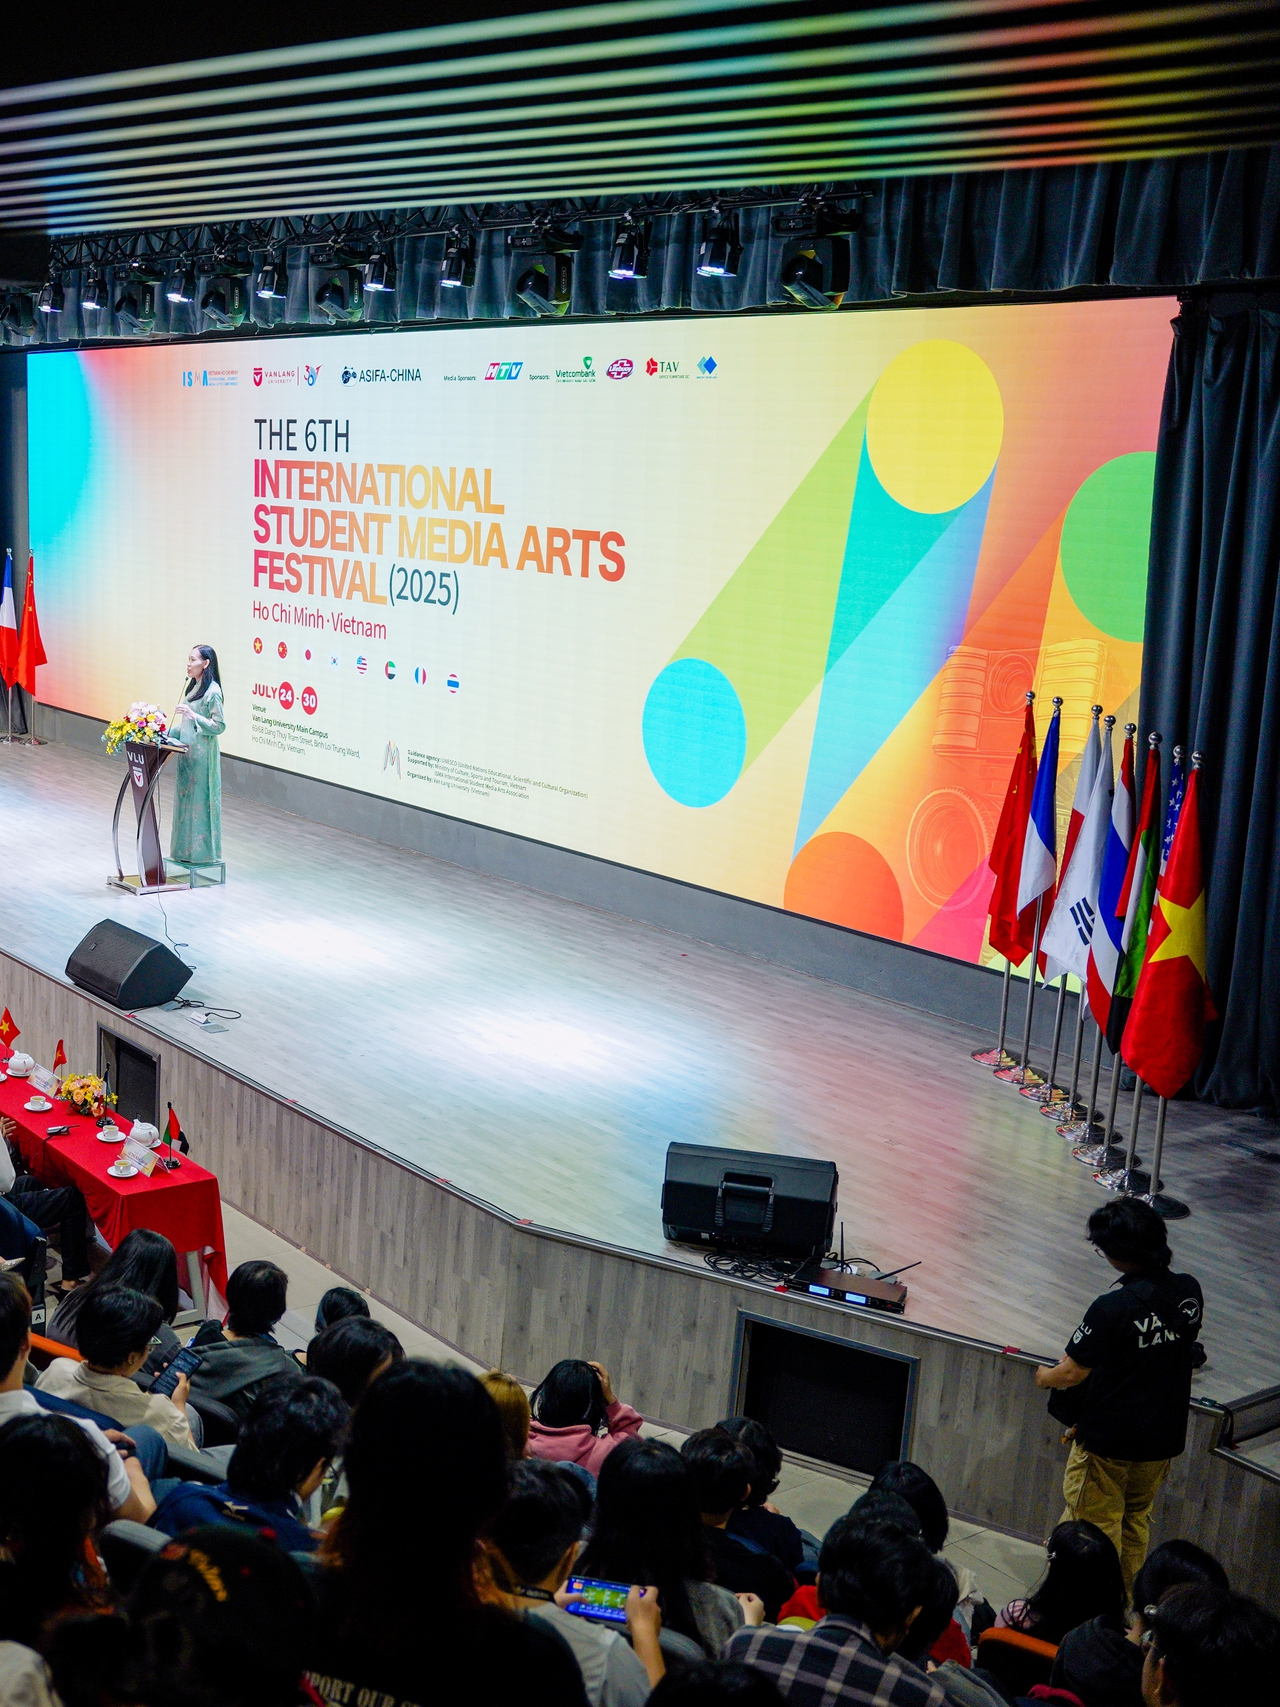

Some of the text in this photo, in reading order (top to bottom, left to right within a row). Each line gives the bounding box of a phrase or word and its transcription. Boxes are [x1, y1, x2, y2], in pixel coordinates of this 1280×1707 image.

[358, 368, 422, 382] ASIFA-CHINA
[486, 362, 522, 380] HTV
[556, 370, 596, 378] Vietcombank
[660, 362, 680, 372] TAV
[254, 418, 350, 453] THE 6TH
[254, 458, 504, 515] INTERNATIONAL
[254, 504, 626, 582] STUDENT MEDIA ARTS
[254, 549, 460, 615] FESTIVAL (2025)
[252, 600, 269, 621] Ho
[272, 602, 291, 624] Chi
[294, 606, 324, 631] Minh
[331, 612, 387, 640] Vietnam
[252, 683, 278, 699] JULY
[280, 688, 292, 702] 24
[303, 694, 316, 708] 30
[252, 704, 266, 713] Venue
[262, 716, 272, 727] Lang
[273, 719, 296, 732] University
[296, 724, 308, 734] Main
[309, 728, 328, 738] Campus
[127, 750, 144, 764] VLU
[408, 749, 425, 758] Guidance
[1138, 1329, 1180, 1348] LAN
